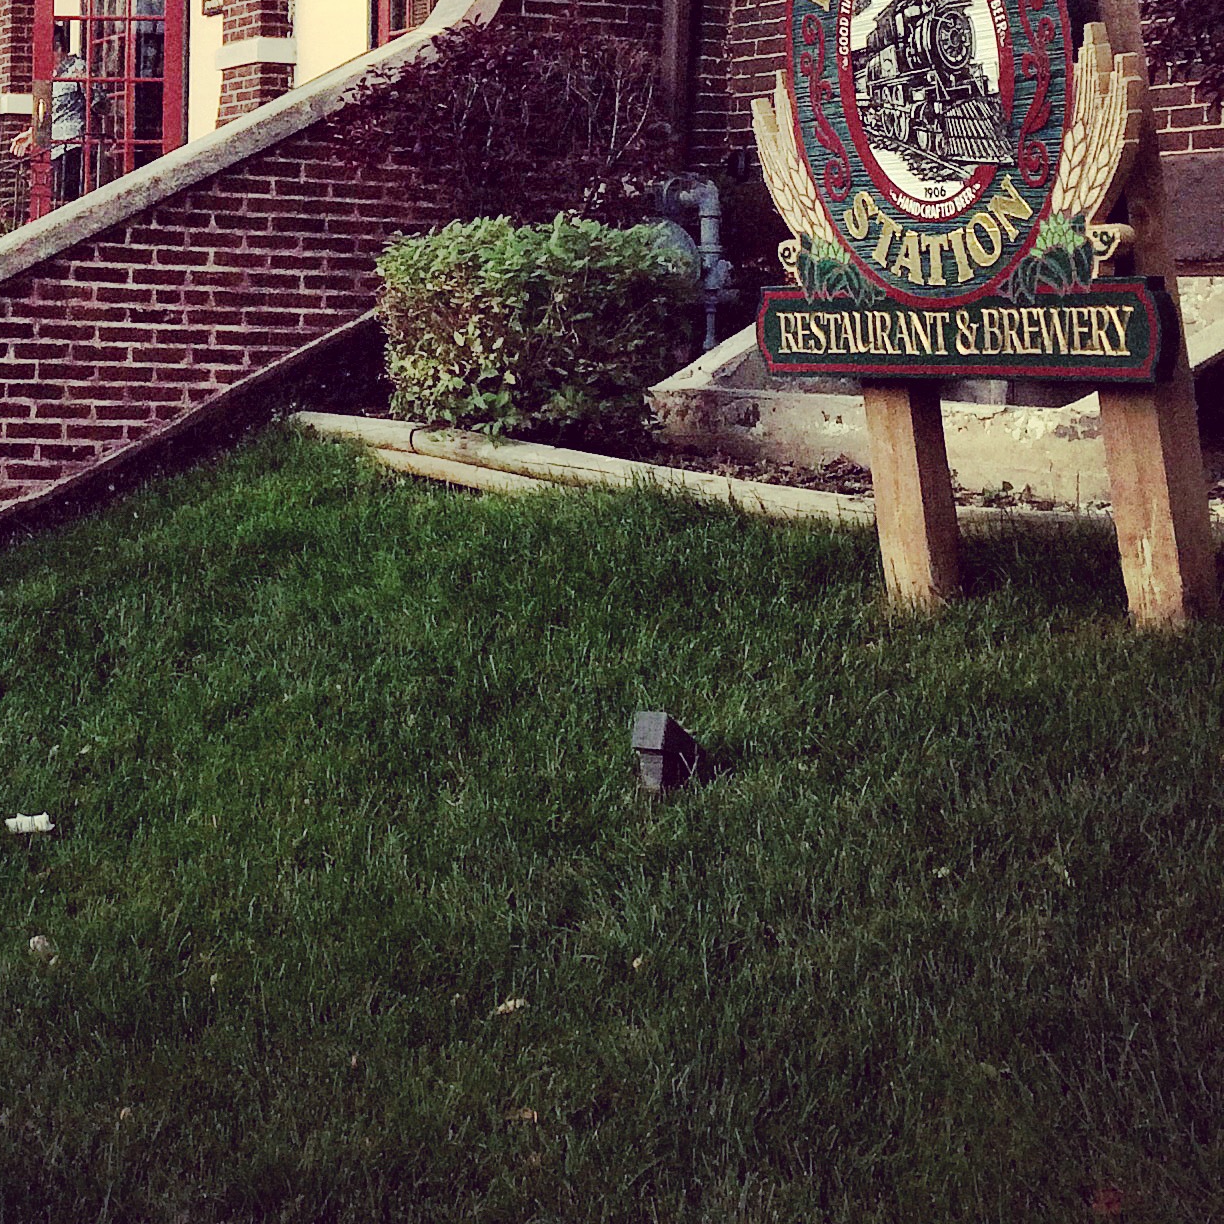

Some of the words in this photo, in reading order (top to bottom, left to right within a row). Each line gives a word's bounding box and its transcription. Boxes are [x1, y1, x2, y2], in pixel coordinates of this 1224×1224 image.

[839, 17, 850, 55] GOOD
[896, 194, 956, 220] HANDCRAFTED
[955, 187, 976, 213] BEER
[924, 185, 947, 198] 1906
[843, 173, 1034, 286] STATION
[777, 309, 950, 356] RESTAURANT
[955, 309, 979, 356] &
[980, 305, 1135, 357] BREWERY
